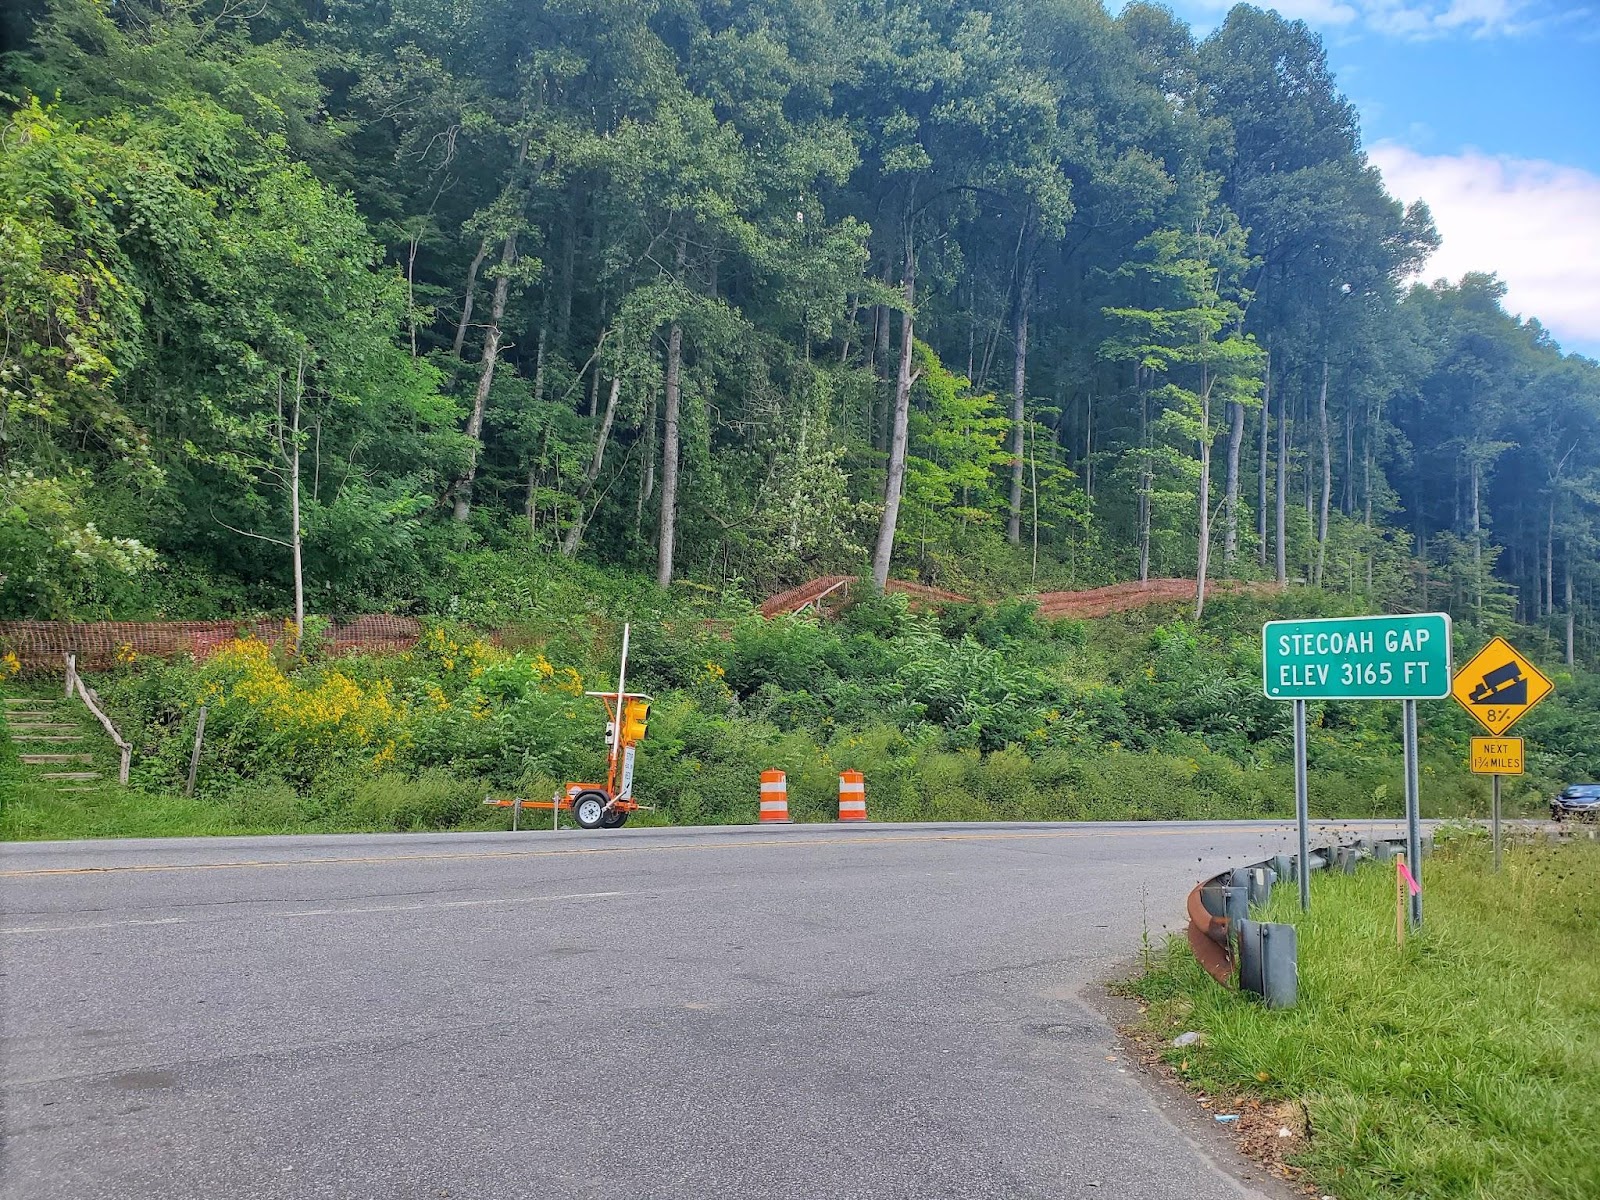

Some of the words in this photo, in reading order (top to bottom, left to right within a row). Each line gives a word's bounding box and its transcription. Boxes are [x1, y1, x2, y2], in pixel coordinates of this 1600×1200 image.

[1278, 631, 1374, 656] STECOAH
[1385, 629, 1430, 653] GAP
[1280, 664, 1330, 686] ELEV
[1341, 662, 1392, 685] 3165
[1404, 661, 1430, 684] FT
[1487, 708, 1511, 722] 8%
[1484, 744, 1508, 754] NEXT
[1490, 758, 1520, 768] MILES
